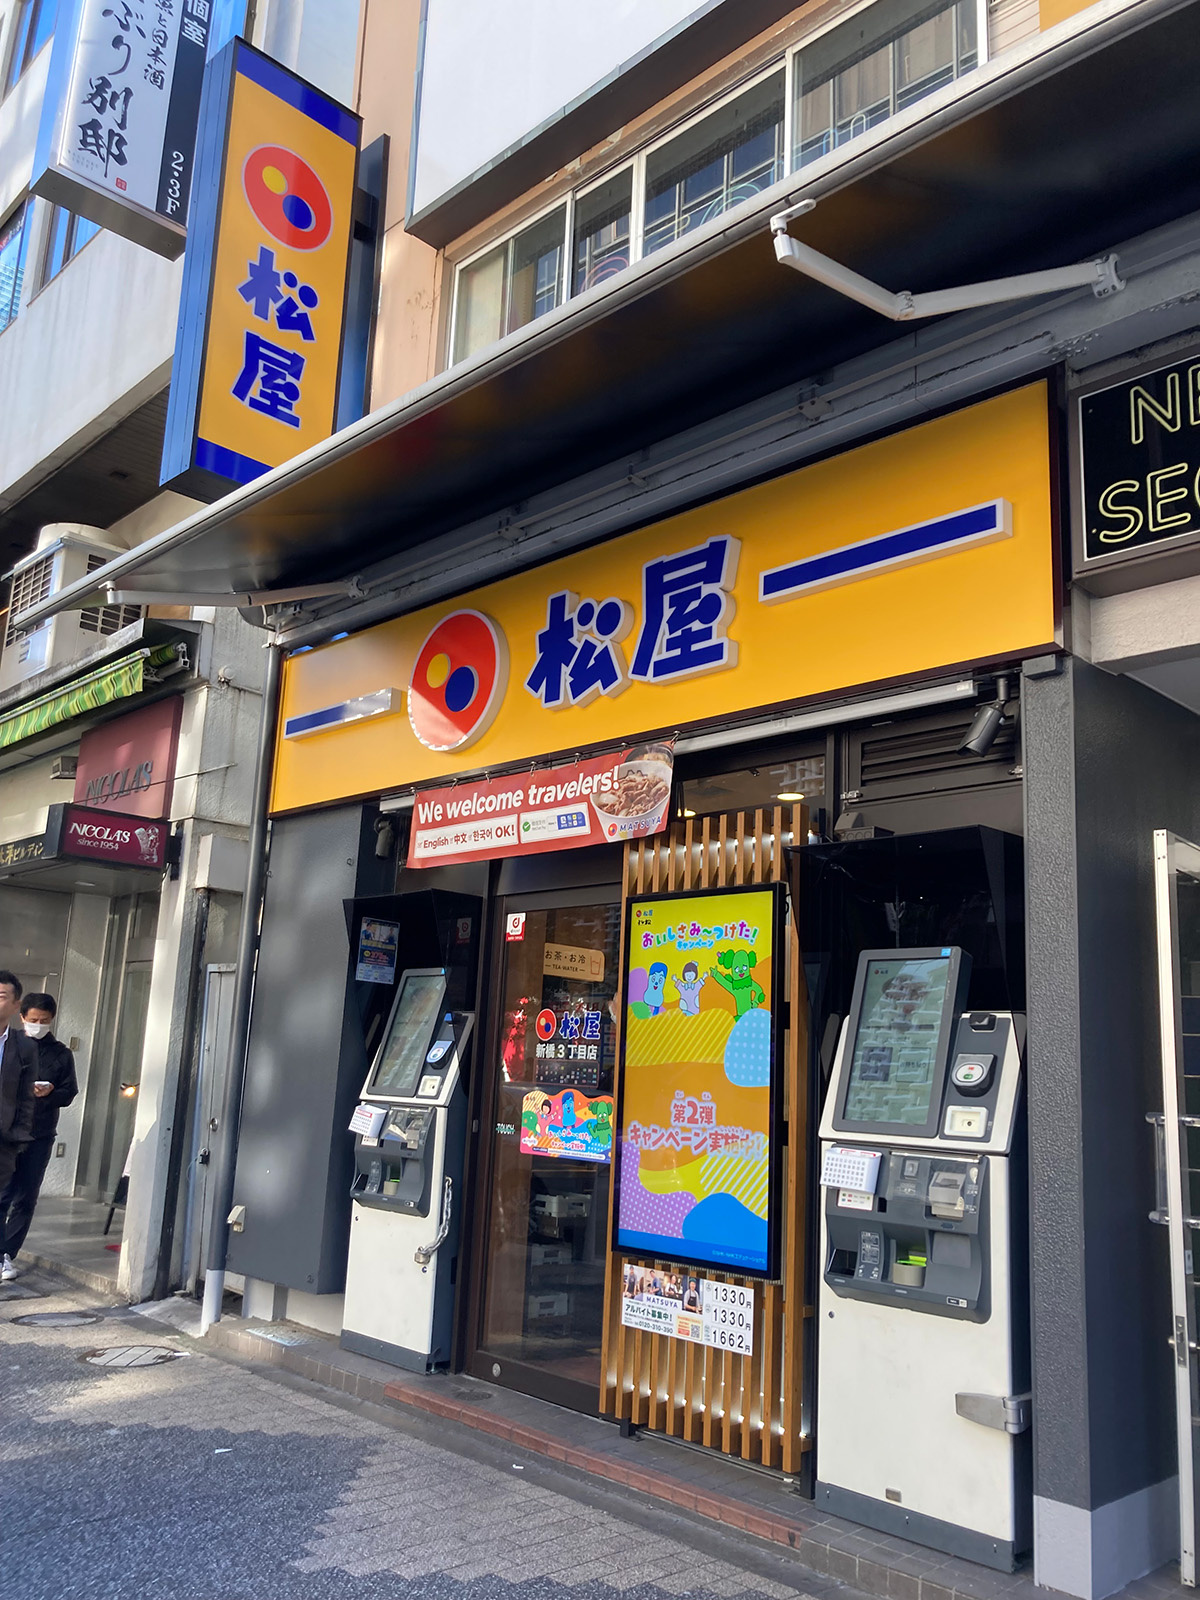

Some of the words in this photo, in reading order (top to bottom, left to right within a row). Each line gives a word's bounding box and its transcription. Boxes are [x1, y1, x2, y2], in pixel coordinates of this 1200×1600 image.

[230, 244, 319, 430] 松屋
[1098, 462, 1200, 543] SE
[524, 534, 740, 710] 松屋
[418, 801, 443, 824] We
[446, 789, 524, 819] welcome
[528, 765, 620, 804] travelers!
[423, 837, 449, 849] English
[453, 832, 467, 845] 中文
[473, 827, 493, 842] 한국어
[495, 824, 515, 838] OK!
[619, 816, 661, 832] MATSUYA
[77, 837, 99, 848] since
[100, 840, 119, 851] 1954
[559, 1010, 601, 1040] 松屋
[673, 1100, 714, 1125] 第2弾
[646, 1296, 678, 1308] MATSUYA
[639, 1321, 674, 1334] 0120-310-390
